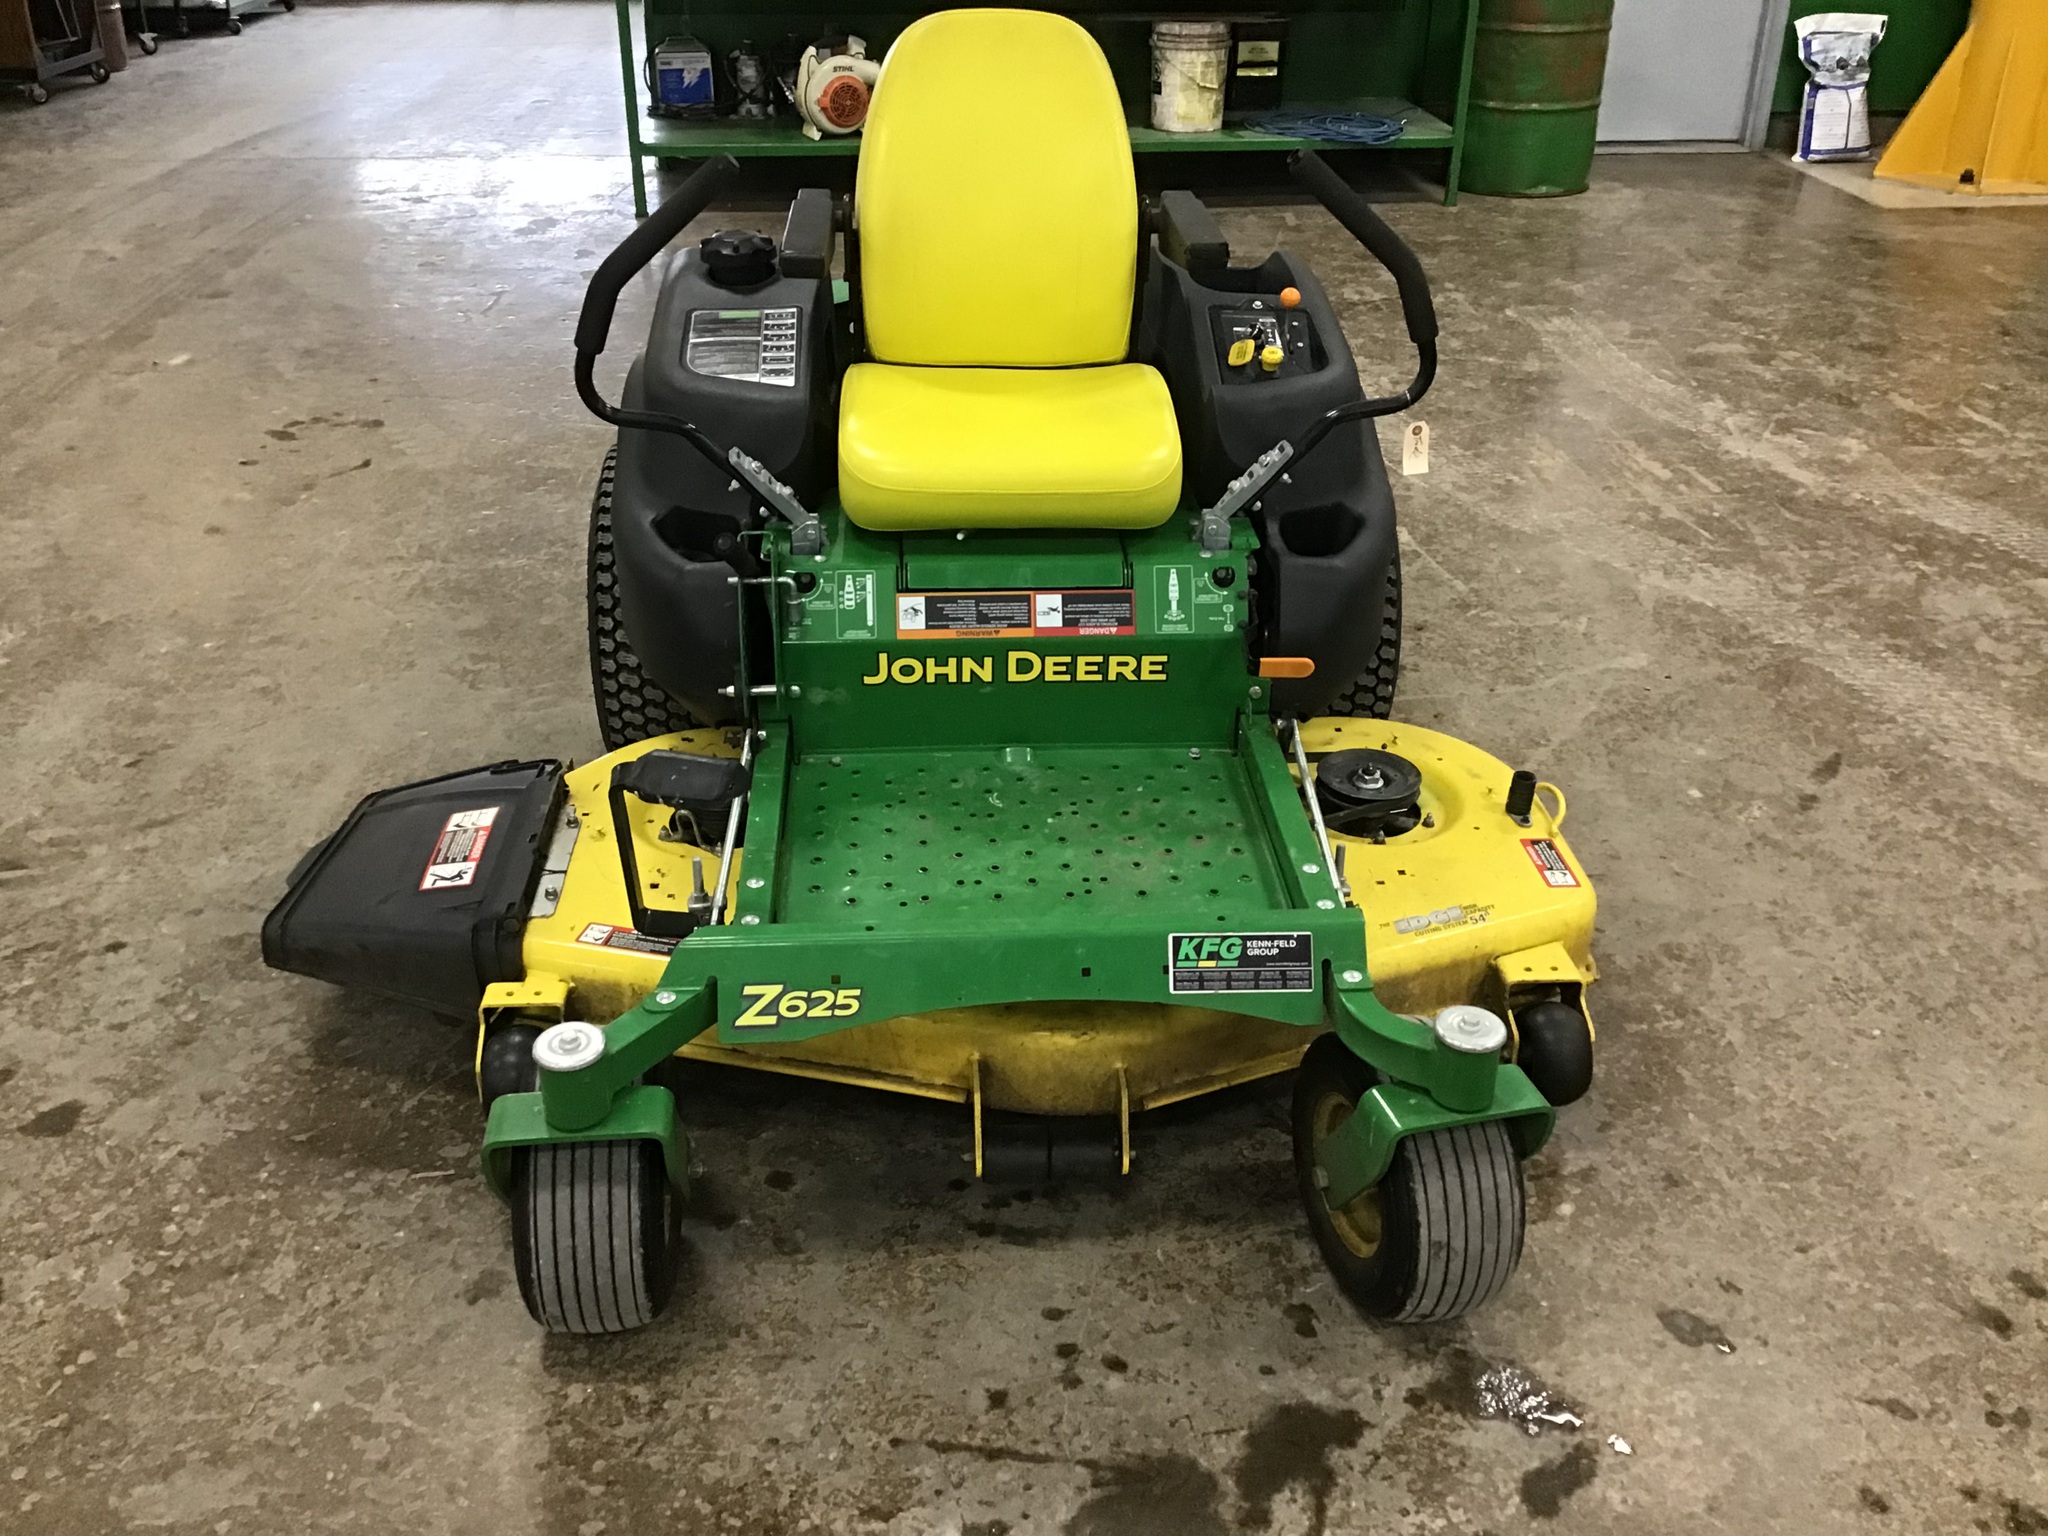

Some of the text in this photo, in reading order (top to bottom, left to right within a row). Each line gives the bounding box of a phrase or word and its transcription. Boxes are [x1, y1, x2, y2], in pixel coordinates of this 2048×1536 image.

[956, 629, 993, 638] WARNING
[1079, 626, 1110, 635] DANGER
[863, 651, 1168, 685] JOHN DEERE
[1465, 904, 1495, 915] CAPACITY
[1414, 926, 1442, 937] CUTTING
[1443, 919, 1469, 930] SYSTEM
[1178, 937, 1243, 960] KFG
[1246, 940, 1297, 948] KENN-FELD
[1246, 948, 1280, 956] GROUP
[734, 984, 861, 1027] Z625
